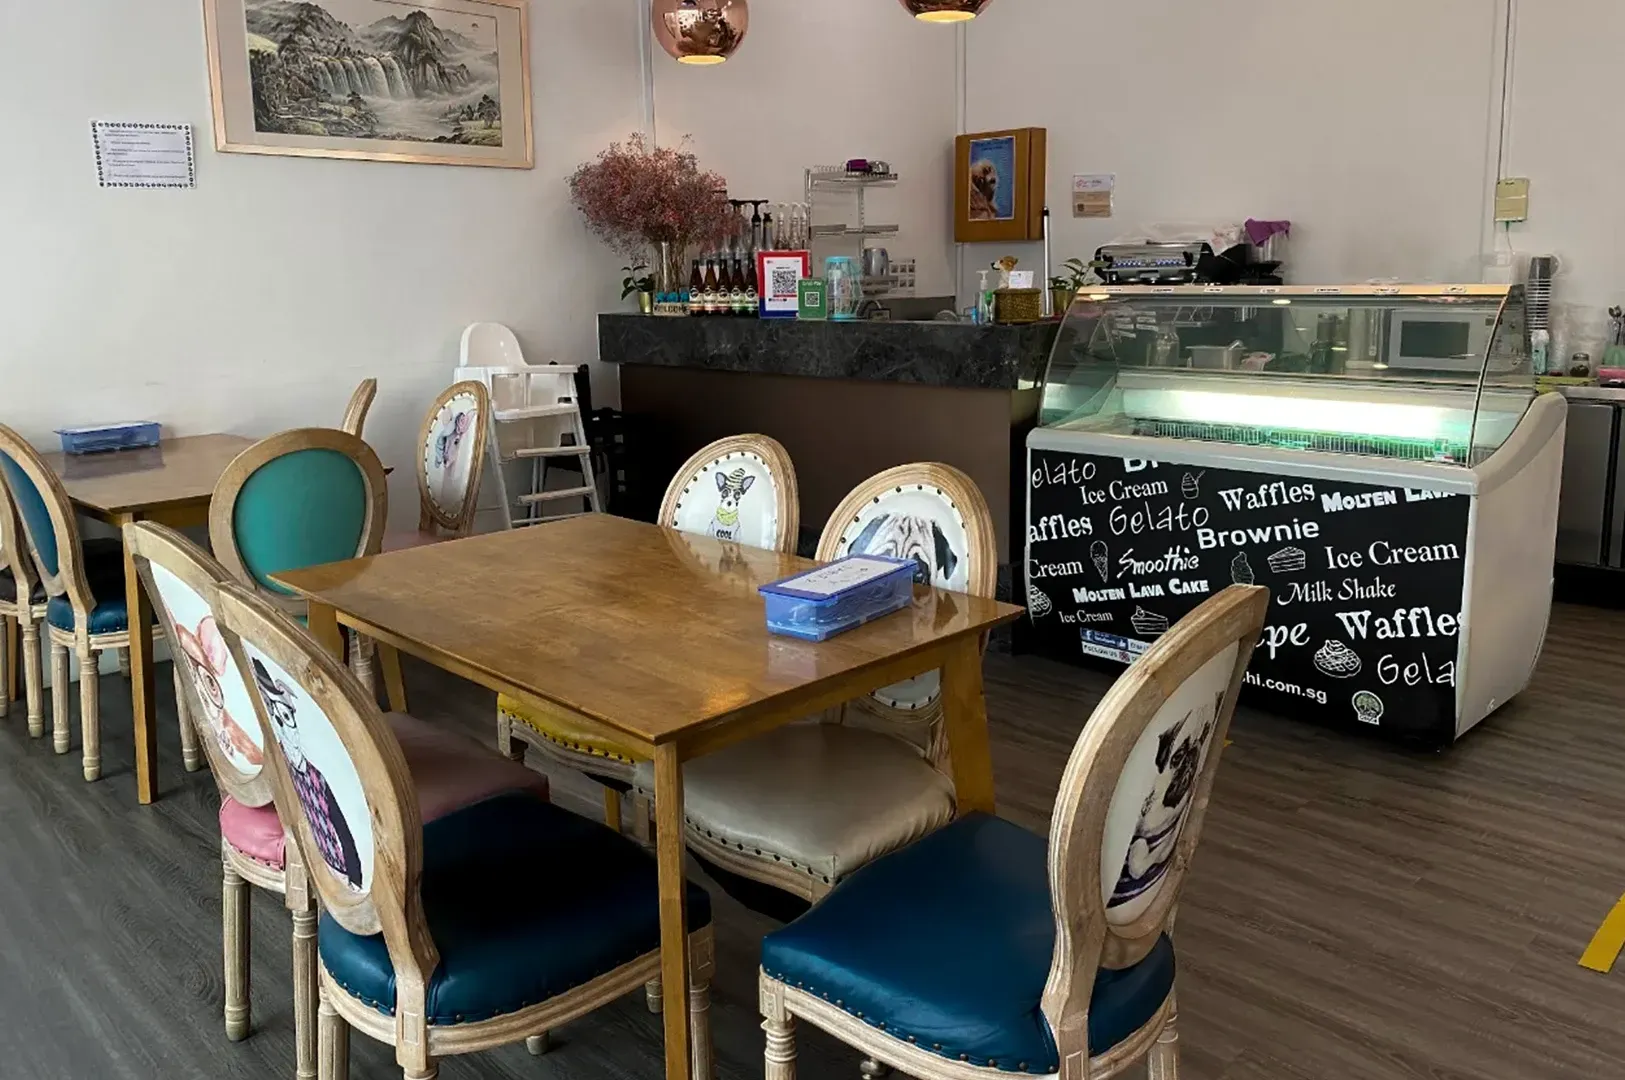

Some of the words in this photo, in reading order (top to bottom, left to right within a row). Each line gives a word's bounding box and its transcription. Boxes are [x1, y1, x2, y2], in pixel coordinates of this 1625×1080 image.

[1079, 485, 1106, 505] Ice
[1109, 480, 1168, 501] Cream
[1217, 481, 1316, 512] Waffles
[1320, 489, 1398, 513] MOLTEN
[1109, 501, 1209, 535] Gelato
[716, 529, 732, 539] COOL
[1196, 518, 1320, 549] Brownie
[1030, 559, 1084, 579] Cream
[1116, 545, 1200, 579] Smoothie
[1324, 546, 1363, 570] Ice
[1368, 540, 1460, 566] Cream
[1276, 581, 1333, 606] Milk
[1338, 576, 1396, 600] Shake
[1058, 611, 1076, 623] Ice
[1076, 609, 1113, 623] Cream
[1256, 622, 1310, 660] pe
[1377, 652, 1455, 688] Gela
[1242, 671, 1328, 705] hi.com.sg
